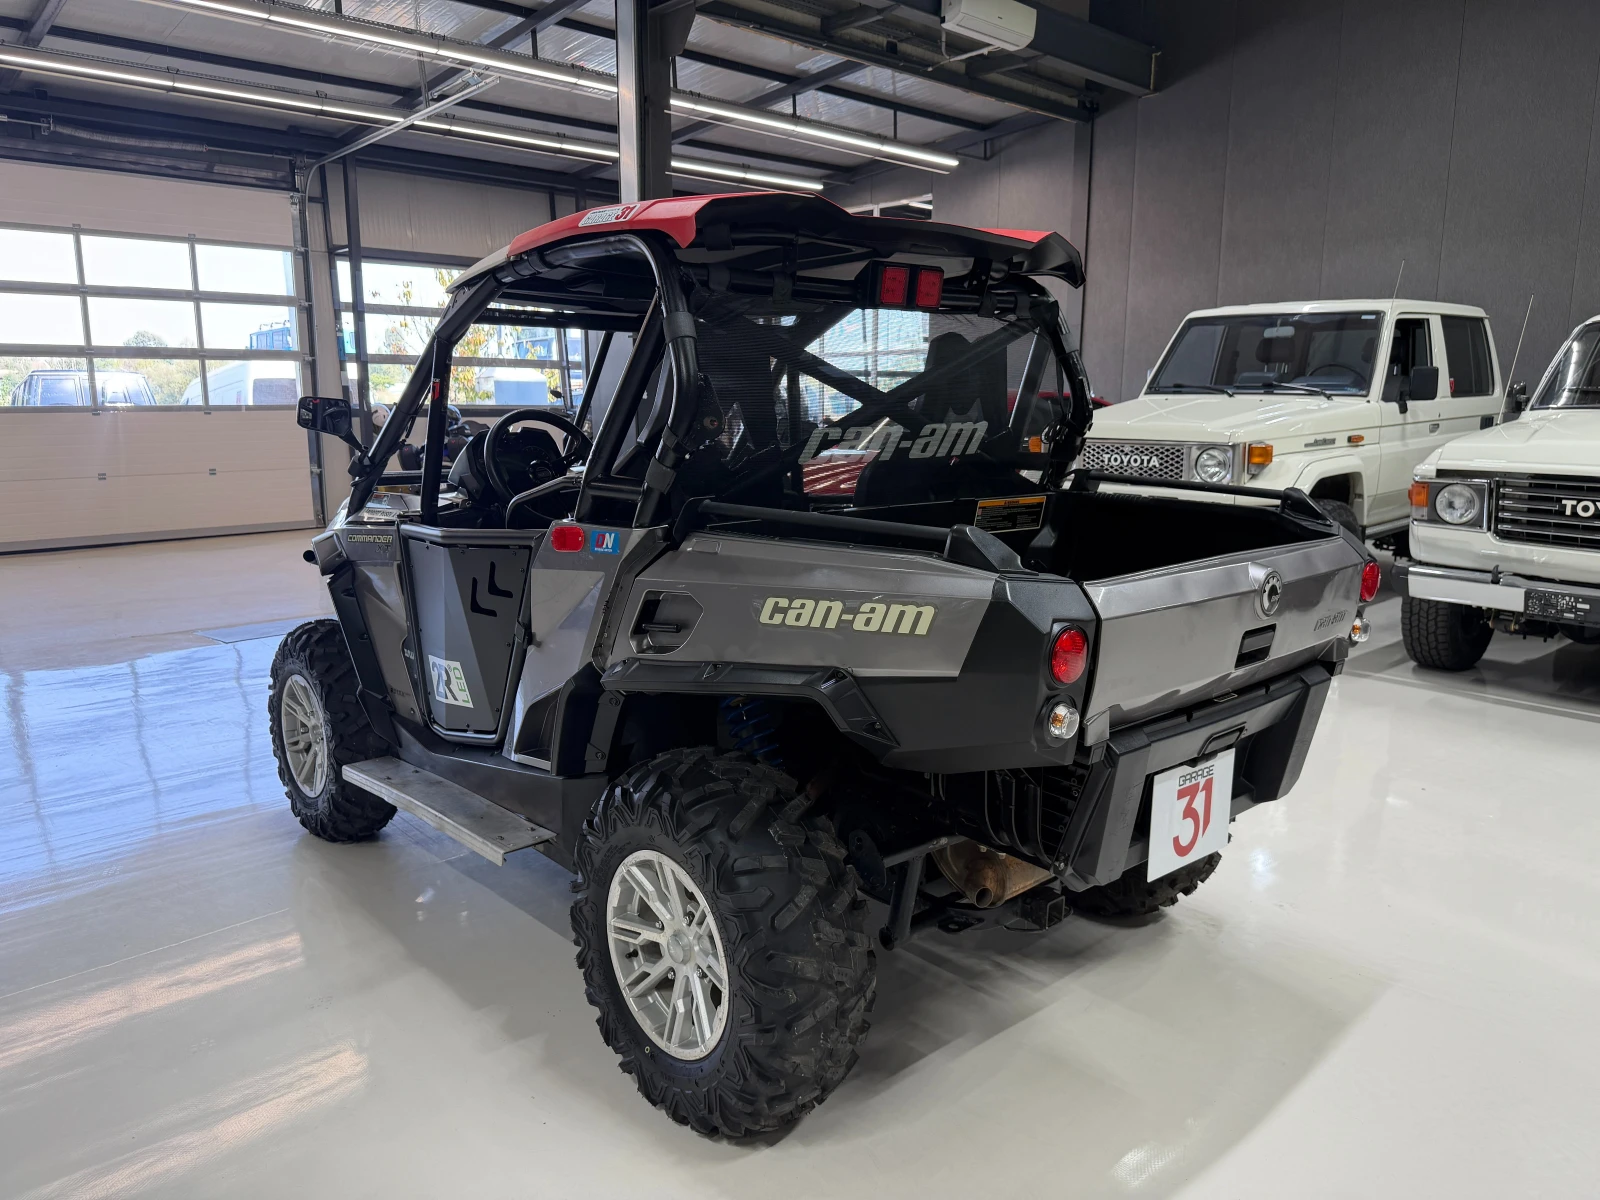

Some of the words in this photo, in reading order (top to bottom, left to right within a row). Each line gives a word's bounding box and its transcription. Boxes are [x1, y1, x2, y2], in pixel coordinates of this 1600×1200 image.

[615, 205, 638, 220] 31
[798, 420, 988, 465] can-am
[1102, 453, 1160, 468] TOYOTA
[347, 534, 393, 543] COMMANDER
[759, 597, 935, 635] can-am
[452, 666, 471, 704] LED
[1178, 764, 1215, 787] GARAGE
[1172, 776, 1214, 857] 31
